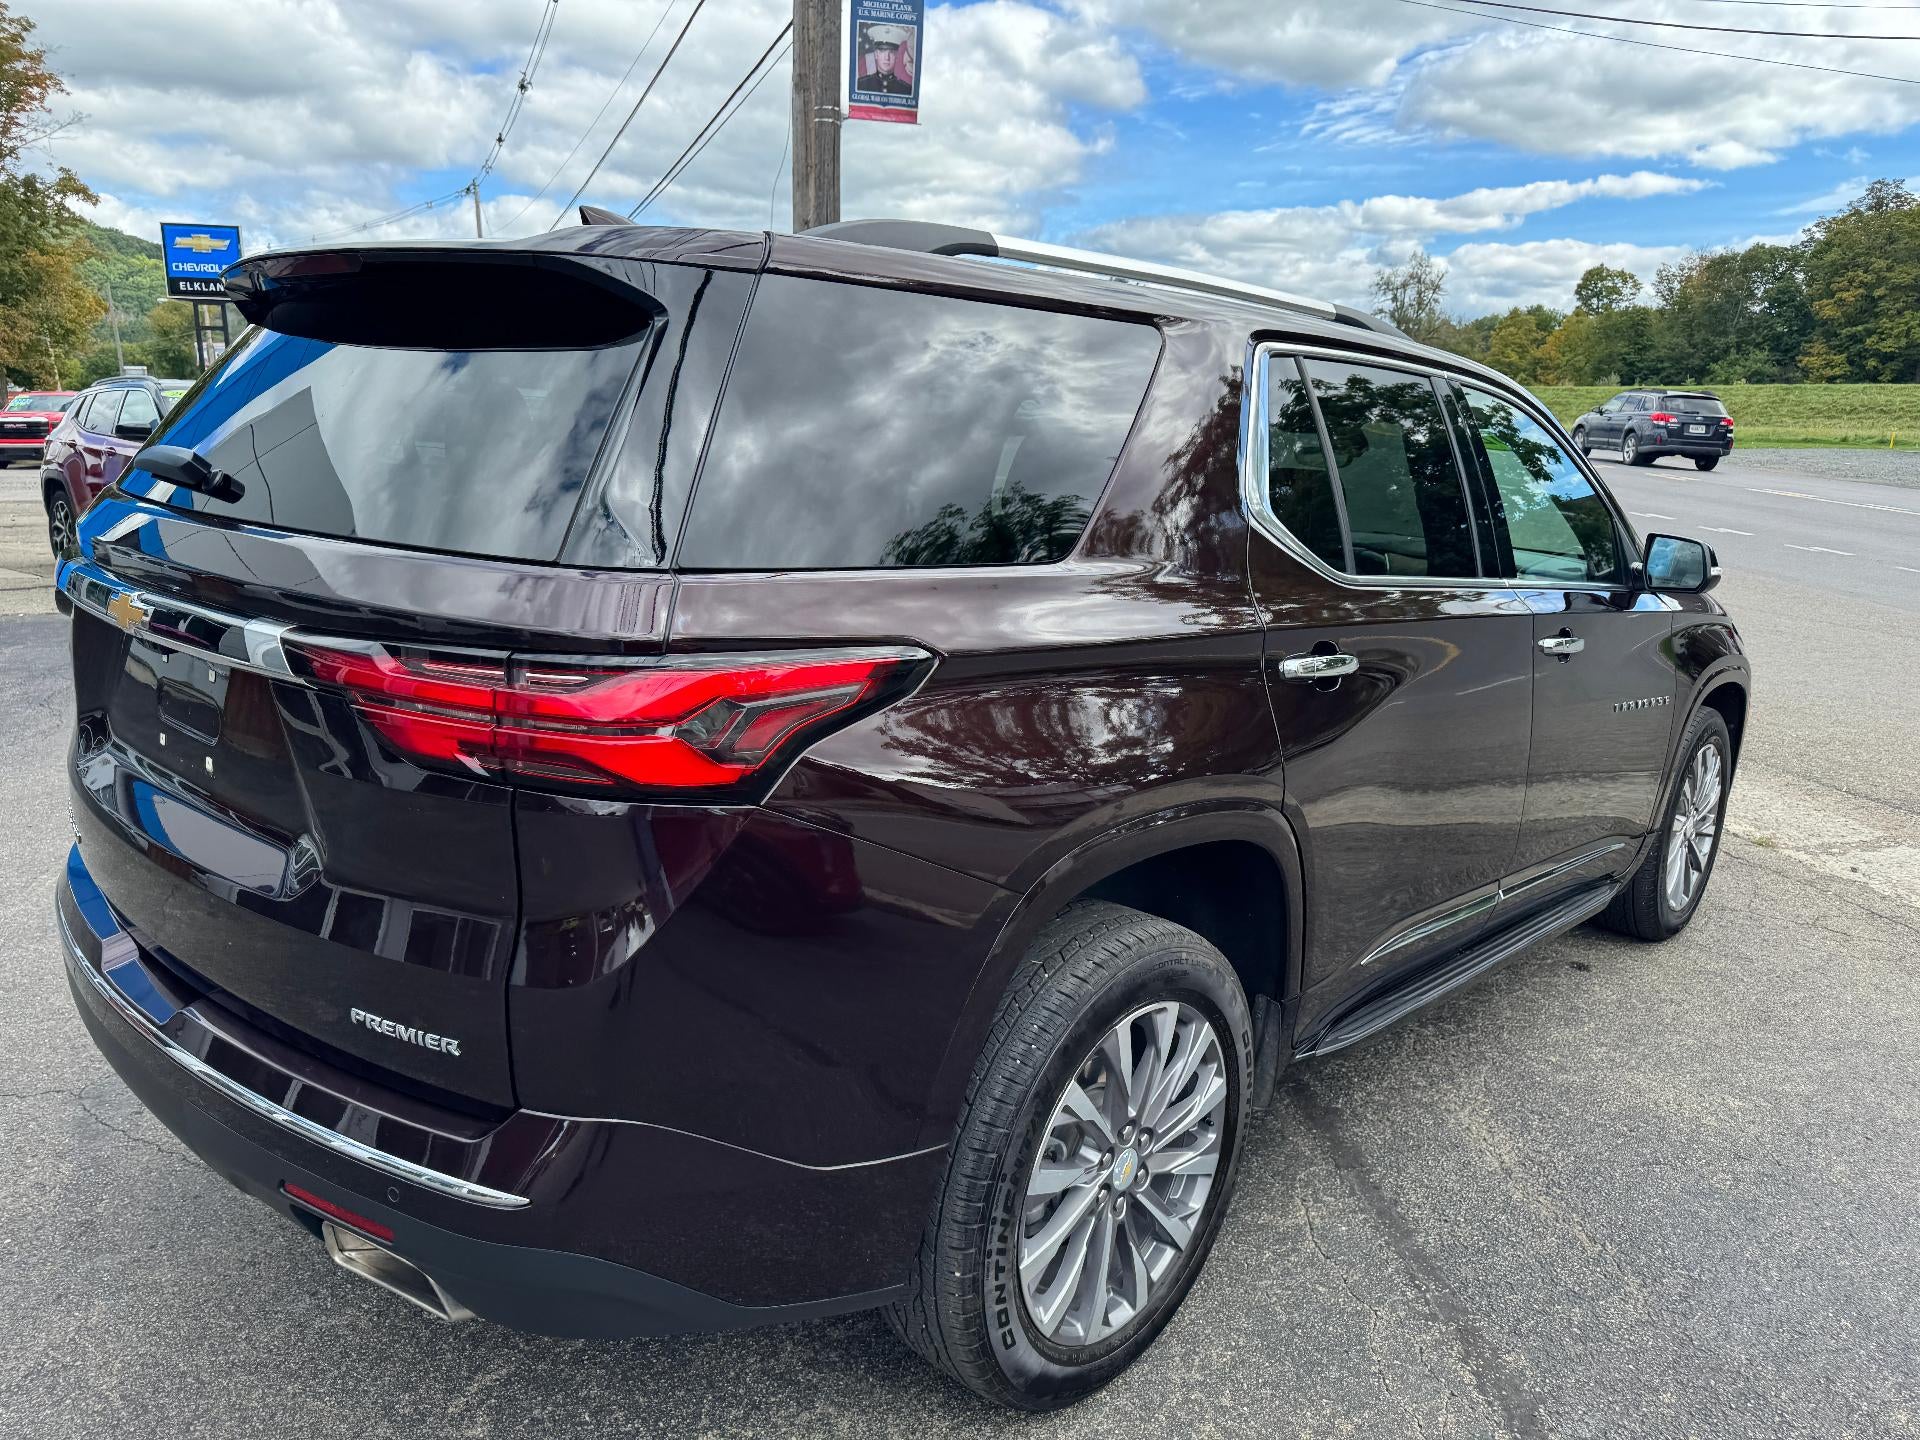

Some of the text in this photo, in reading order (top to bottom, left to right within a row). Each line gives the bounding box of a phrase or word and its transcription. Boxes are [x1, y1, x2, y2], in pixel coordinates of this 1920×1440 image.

[863, 1, 912, 11] MICHAEL PLANK
[870, 10, 895, 18] MARINE
[895, 12, 916, 20] CORPS
[179, 281, 225, 292] ELKLAN
[1614, 695, 1670, 712] TRAVERSE
[350, 1007, 461, 1056] PREMIER
